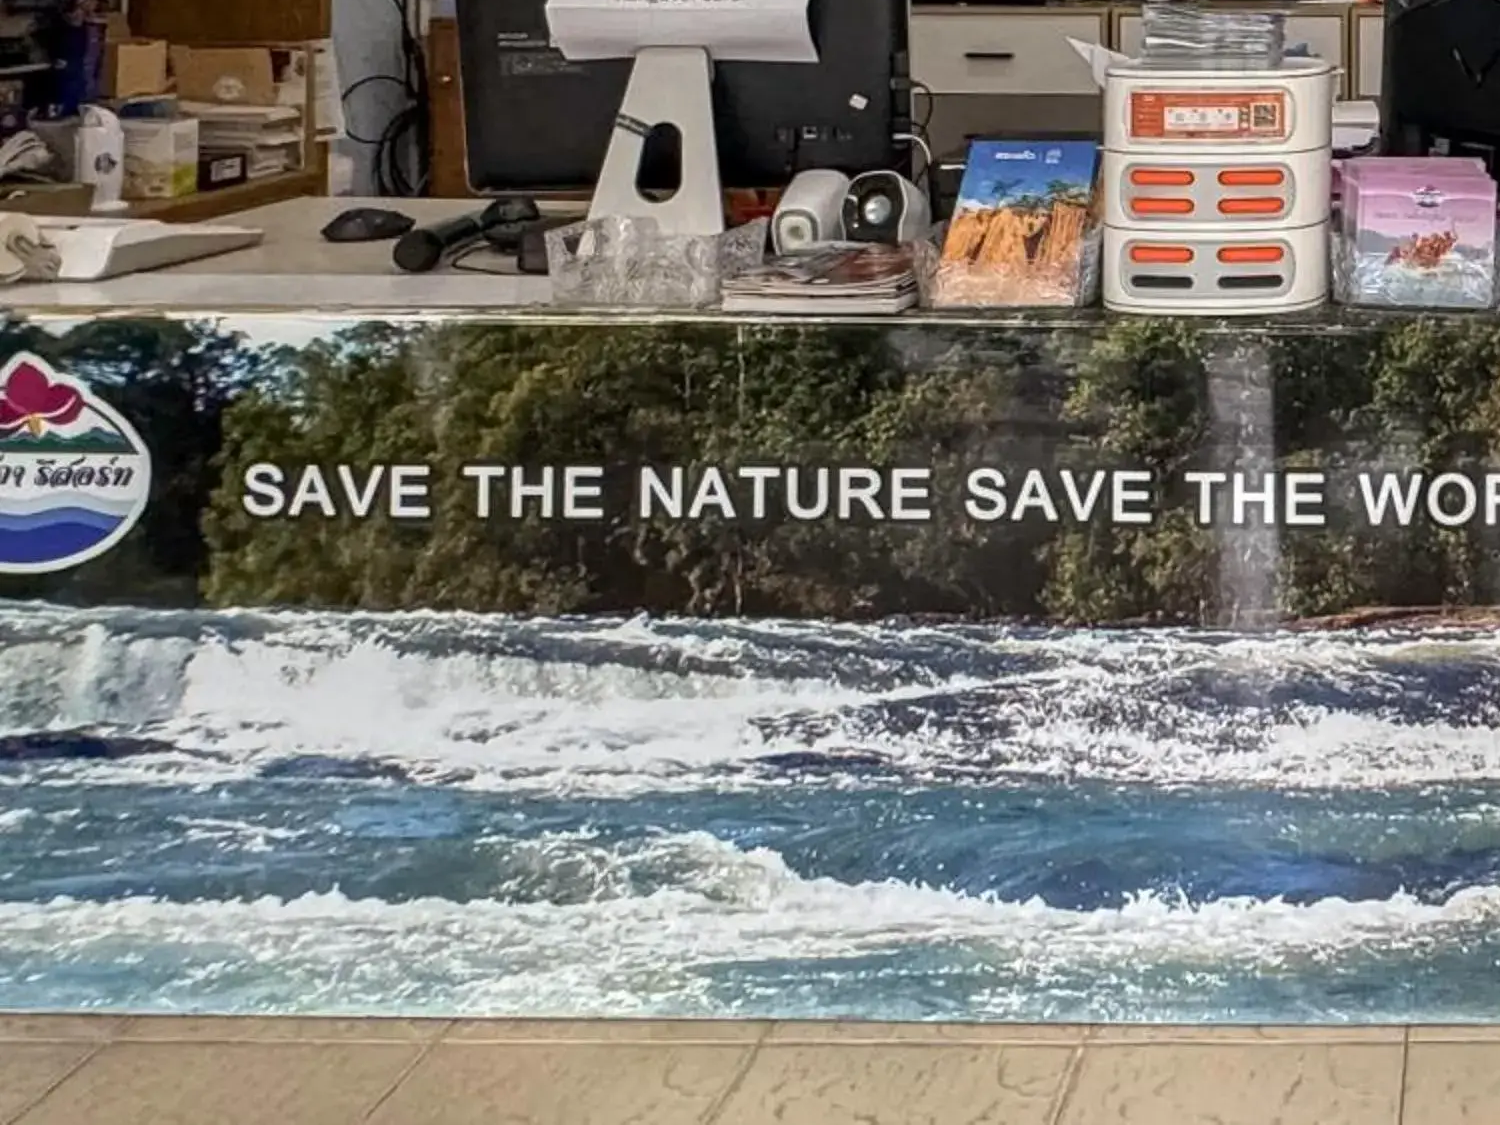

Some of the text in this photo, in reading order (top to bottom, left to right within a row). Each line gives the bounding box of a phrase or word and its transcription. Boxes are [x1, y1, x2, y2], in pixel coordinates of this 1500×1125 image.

[242, 462, 430, 519] SAVE
[463, 464, 604, 520] THE
[639, 467, 932, 522] NATURE
[964, 467, 1152, 523] SAVE
[1185, 471, 1325, 526] THE
